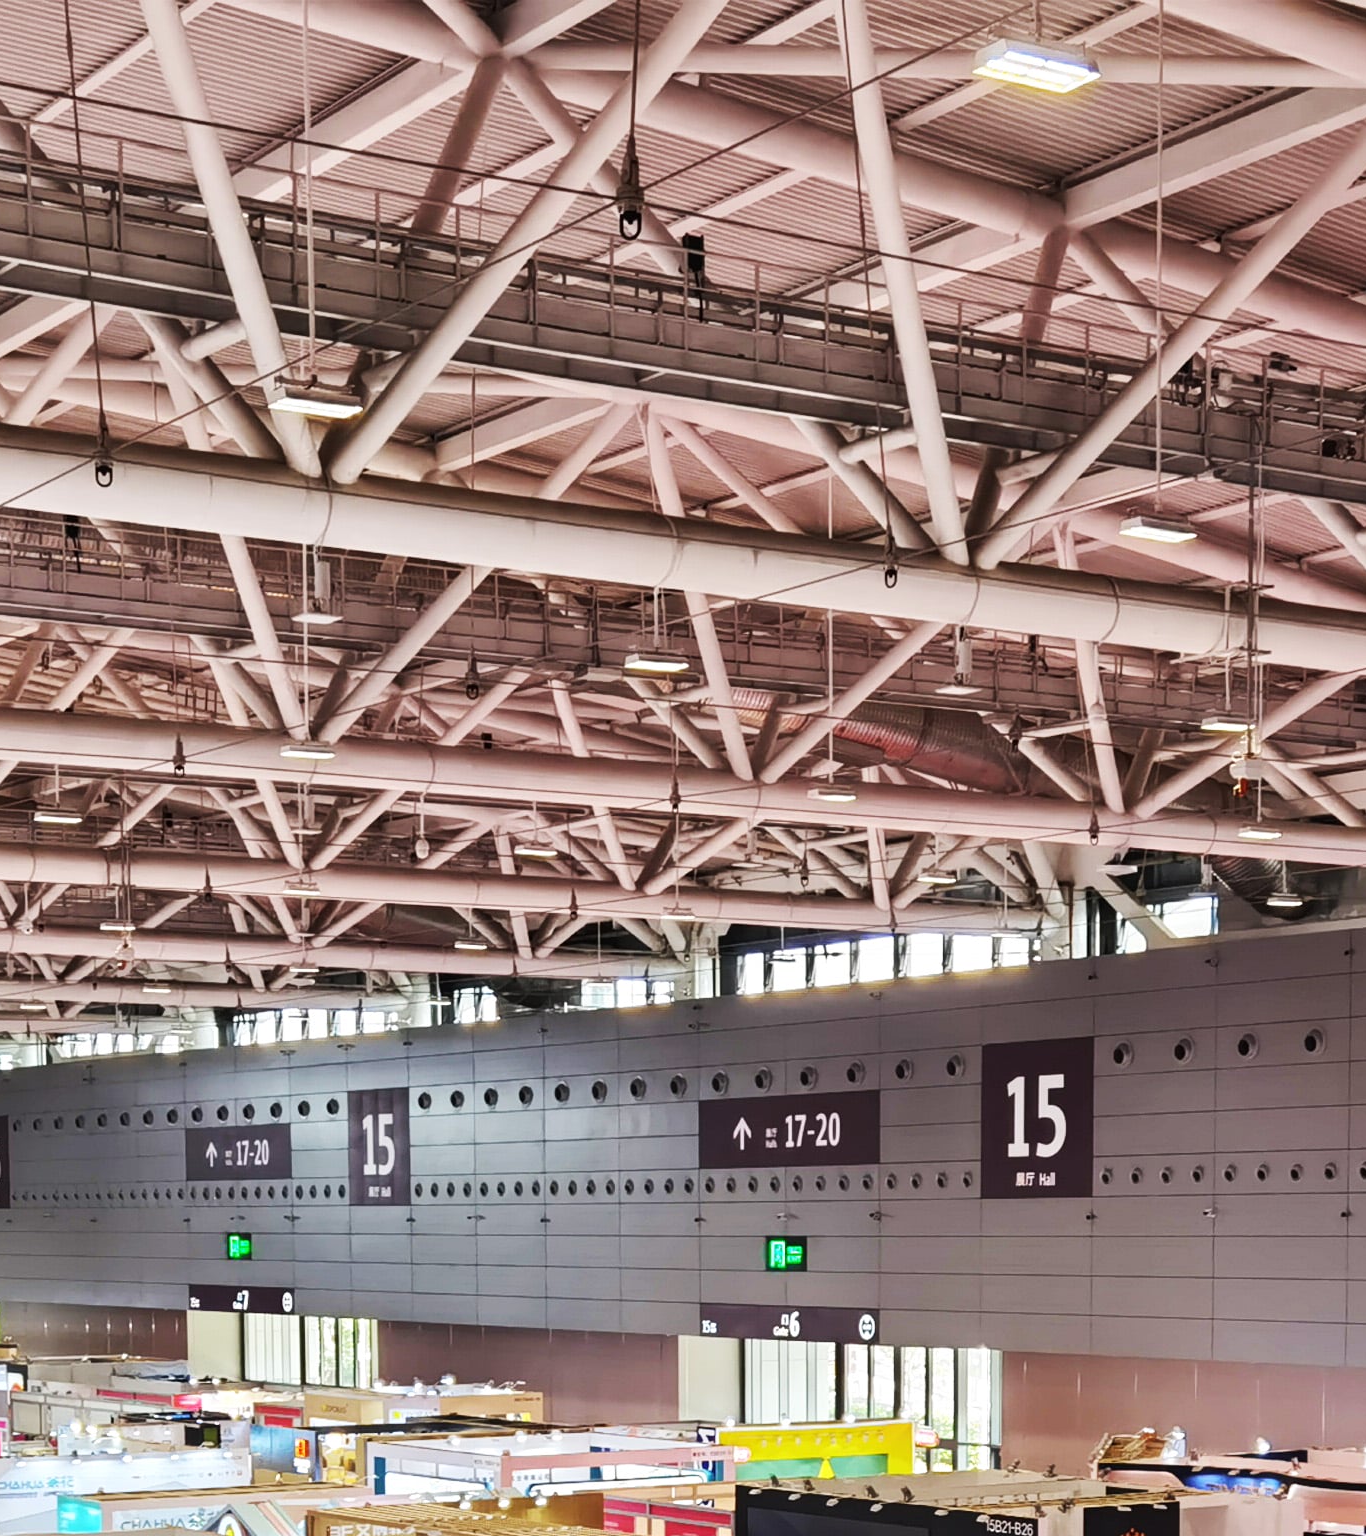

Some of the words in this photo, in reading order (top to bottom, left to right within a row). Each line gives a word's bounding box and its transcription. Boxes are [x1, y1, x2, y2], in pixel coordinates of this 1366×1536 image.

[785, 1111, 841, 1149] 17-20
[1007, 1073, 1067, 1158] 15
[235, 1138, 270, 1168] 17-20
[362, 1113, 396, 1176] 15
[1015, 1172, 1036, 1187] 展厅
[1038, 1171, 1056, 1187] Hall
[789, 1311, 800, 1338] 6
